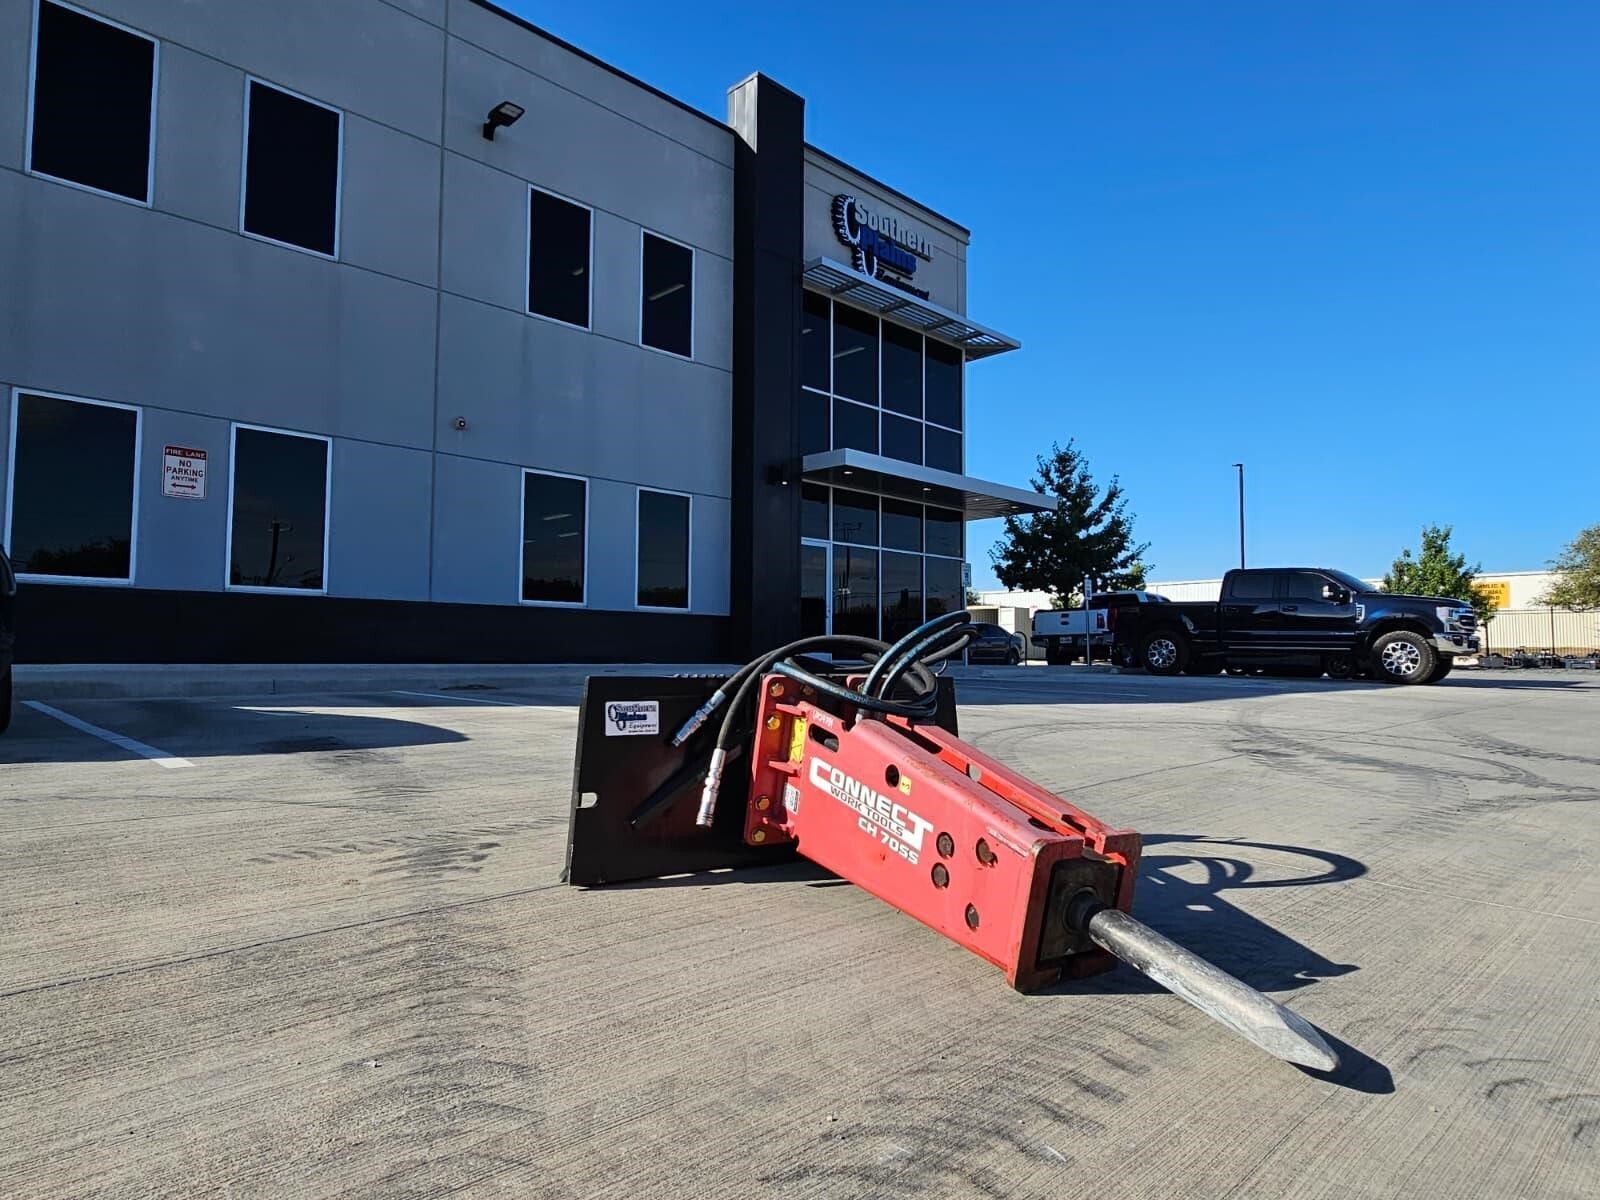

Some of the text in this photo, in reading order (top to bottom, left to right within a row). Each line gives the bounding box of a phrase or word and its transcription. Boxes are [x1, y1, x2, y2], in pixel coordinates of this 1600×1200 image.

[854, 200, 935, 257] Southern
[179, 460, 192, 468] NO
[186, 451, 206, 459] LANE
[166, 466, 204, 478] PARKING
[808, 756, 934, 852] CONNECT
[830, 785, 862, 812] WORK
[865, 807, 904, 838] TOOLS
[858, 816, 878, 839] CH
